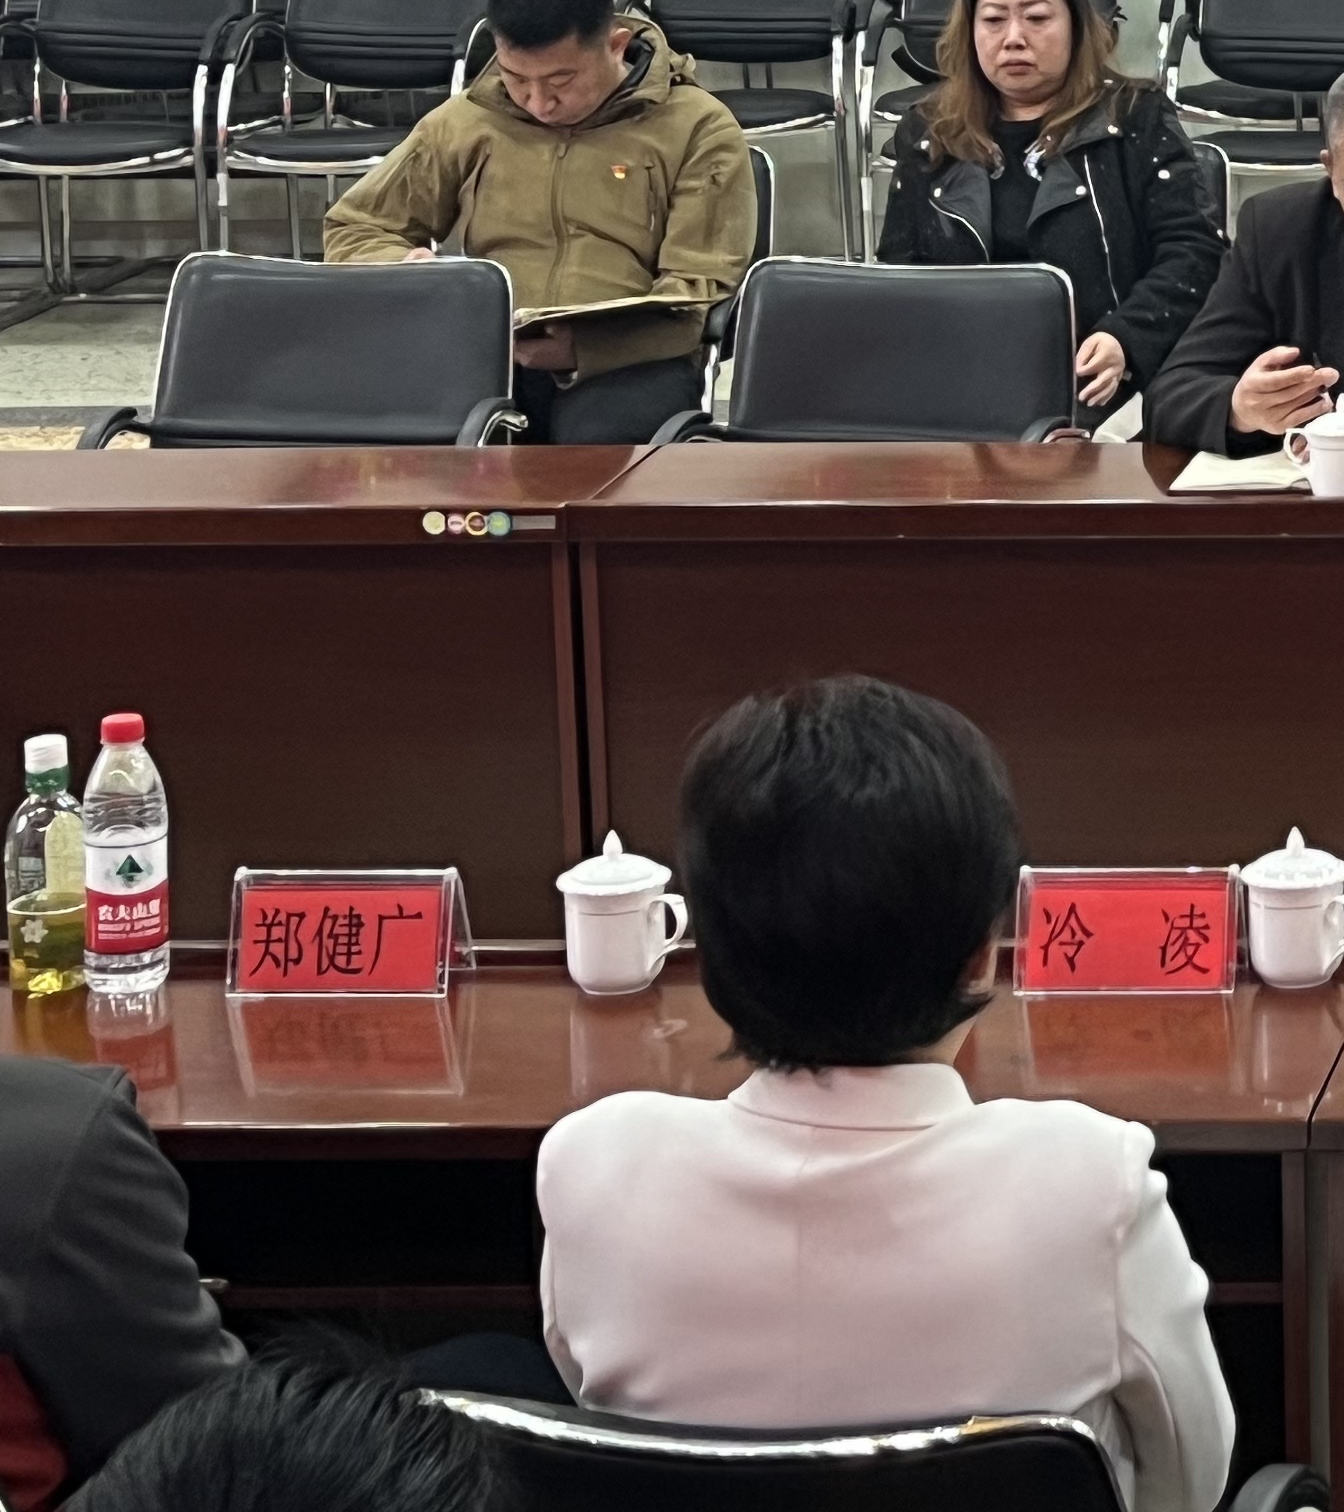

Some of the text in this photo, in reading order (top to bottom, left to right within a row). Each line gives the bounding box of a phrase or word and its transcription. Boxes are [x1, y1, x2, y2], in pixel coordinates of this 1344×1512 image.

[249, 903, 424, 978] 郑健广
[1039, 902, 1211, 976] 冷 凌
